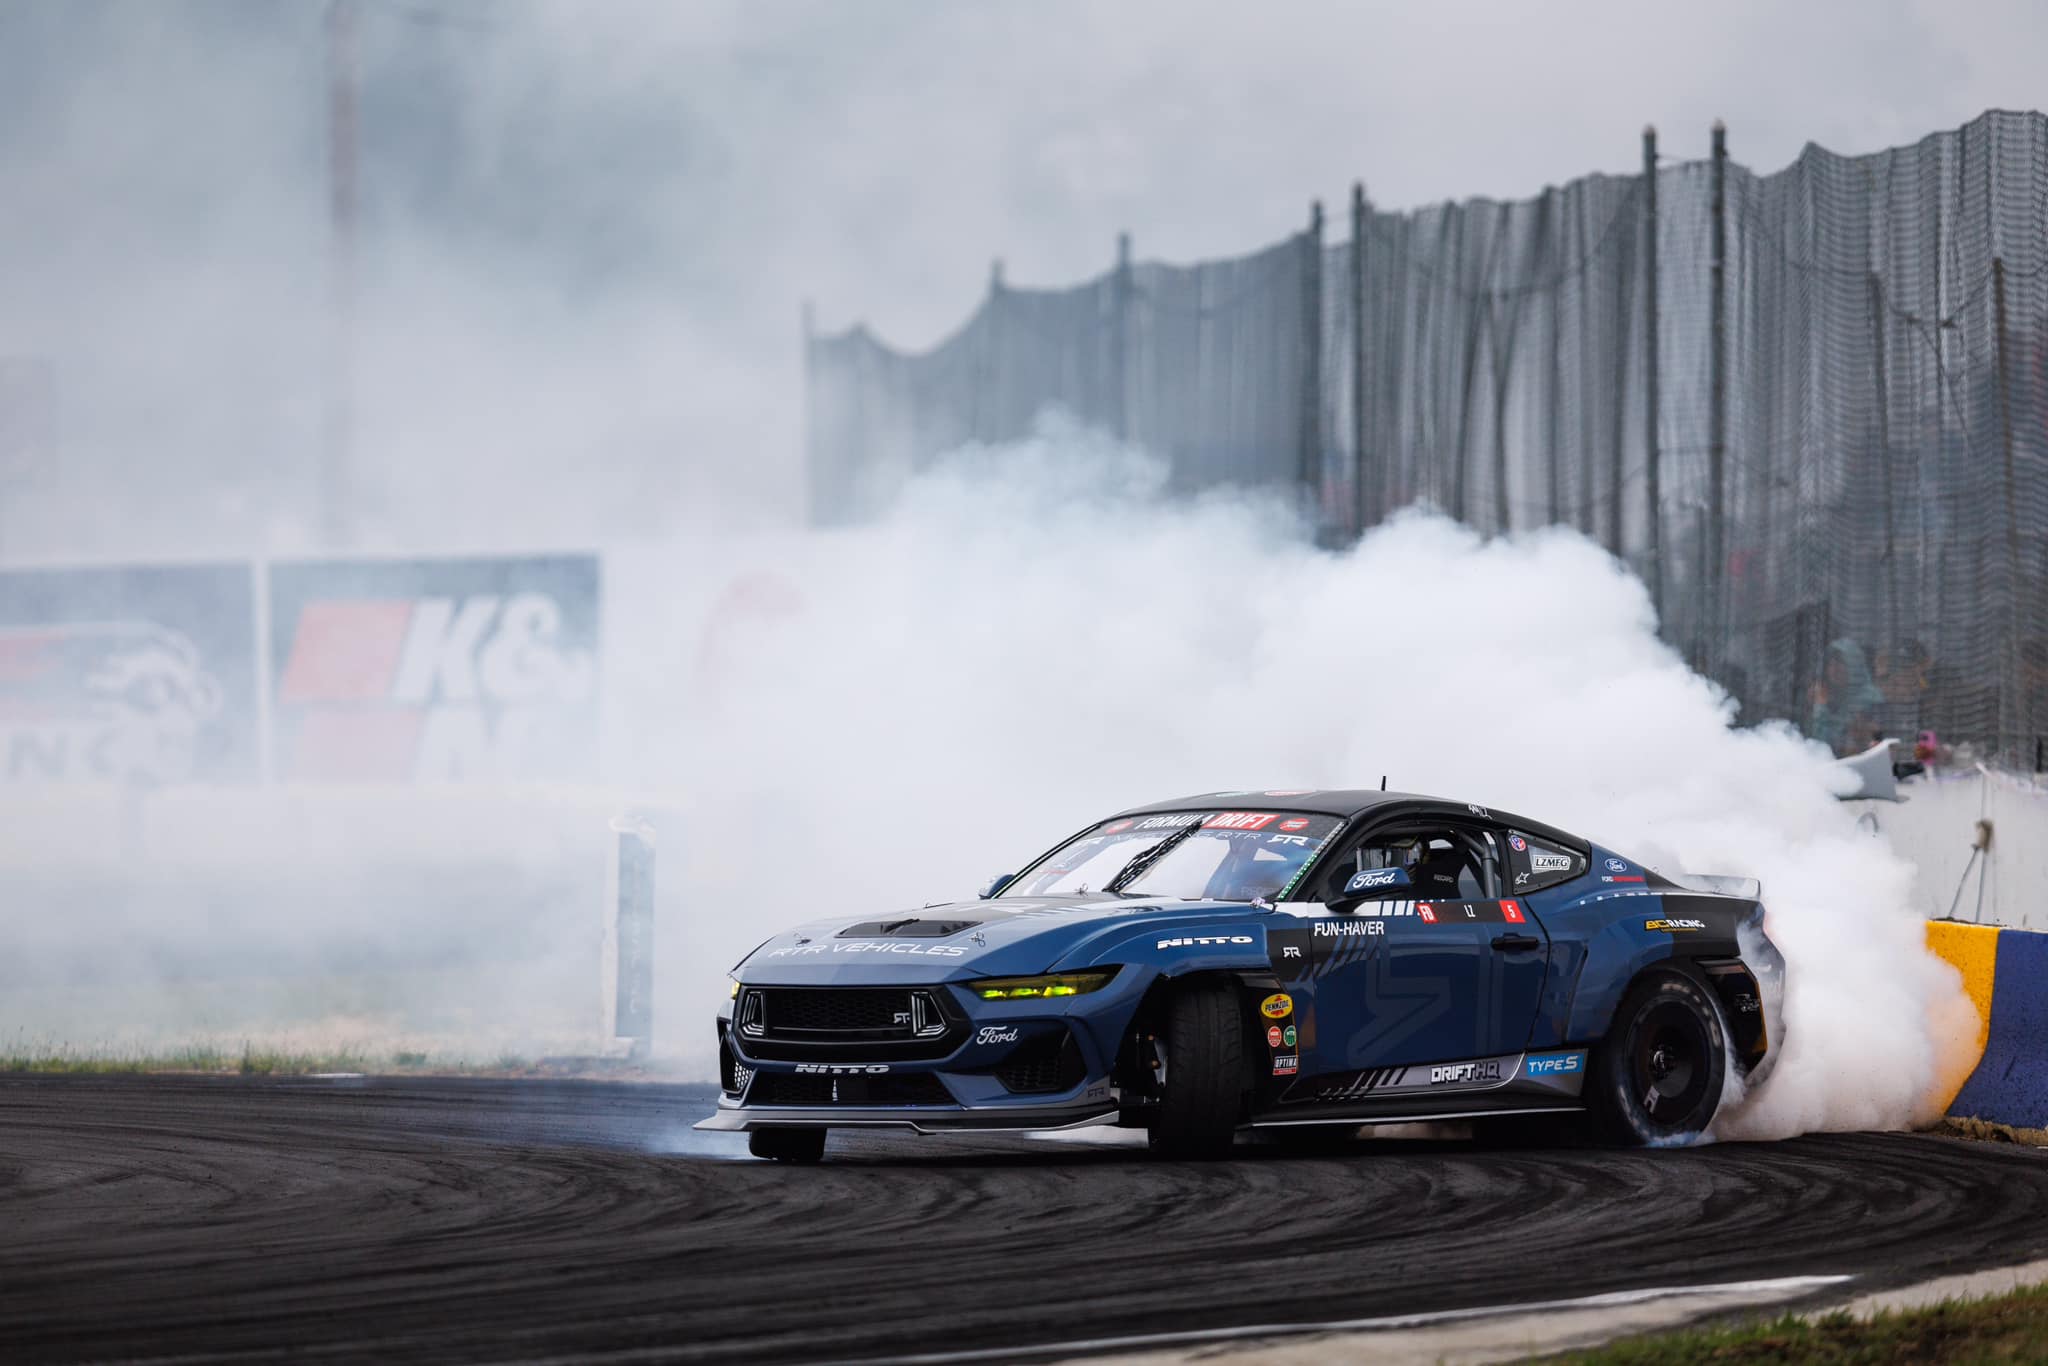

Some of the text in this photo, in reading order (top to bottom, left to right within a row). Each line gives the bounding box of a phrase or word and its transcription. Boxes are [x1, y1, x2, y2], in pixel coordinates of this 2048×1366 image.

[1211, 813, 1274, 829] DRIFT
[1352, 871, 1396, 888] Ford
[1506, 904, 1517, 919] 5
[1313, 921, 1385, 936] FUN-HAVER
[833, 942, 970, 957] VEHICLES
[1157, 936, 1254, 950] NITTO
[976, 1026, 1018, 1045] Ford
[794, 1064, 890, 1074] NITTO
